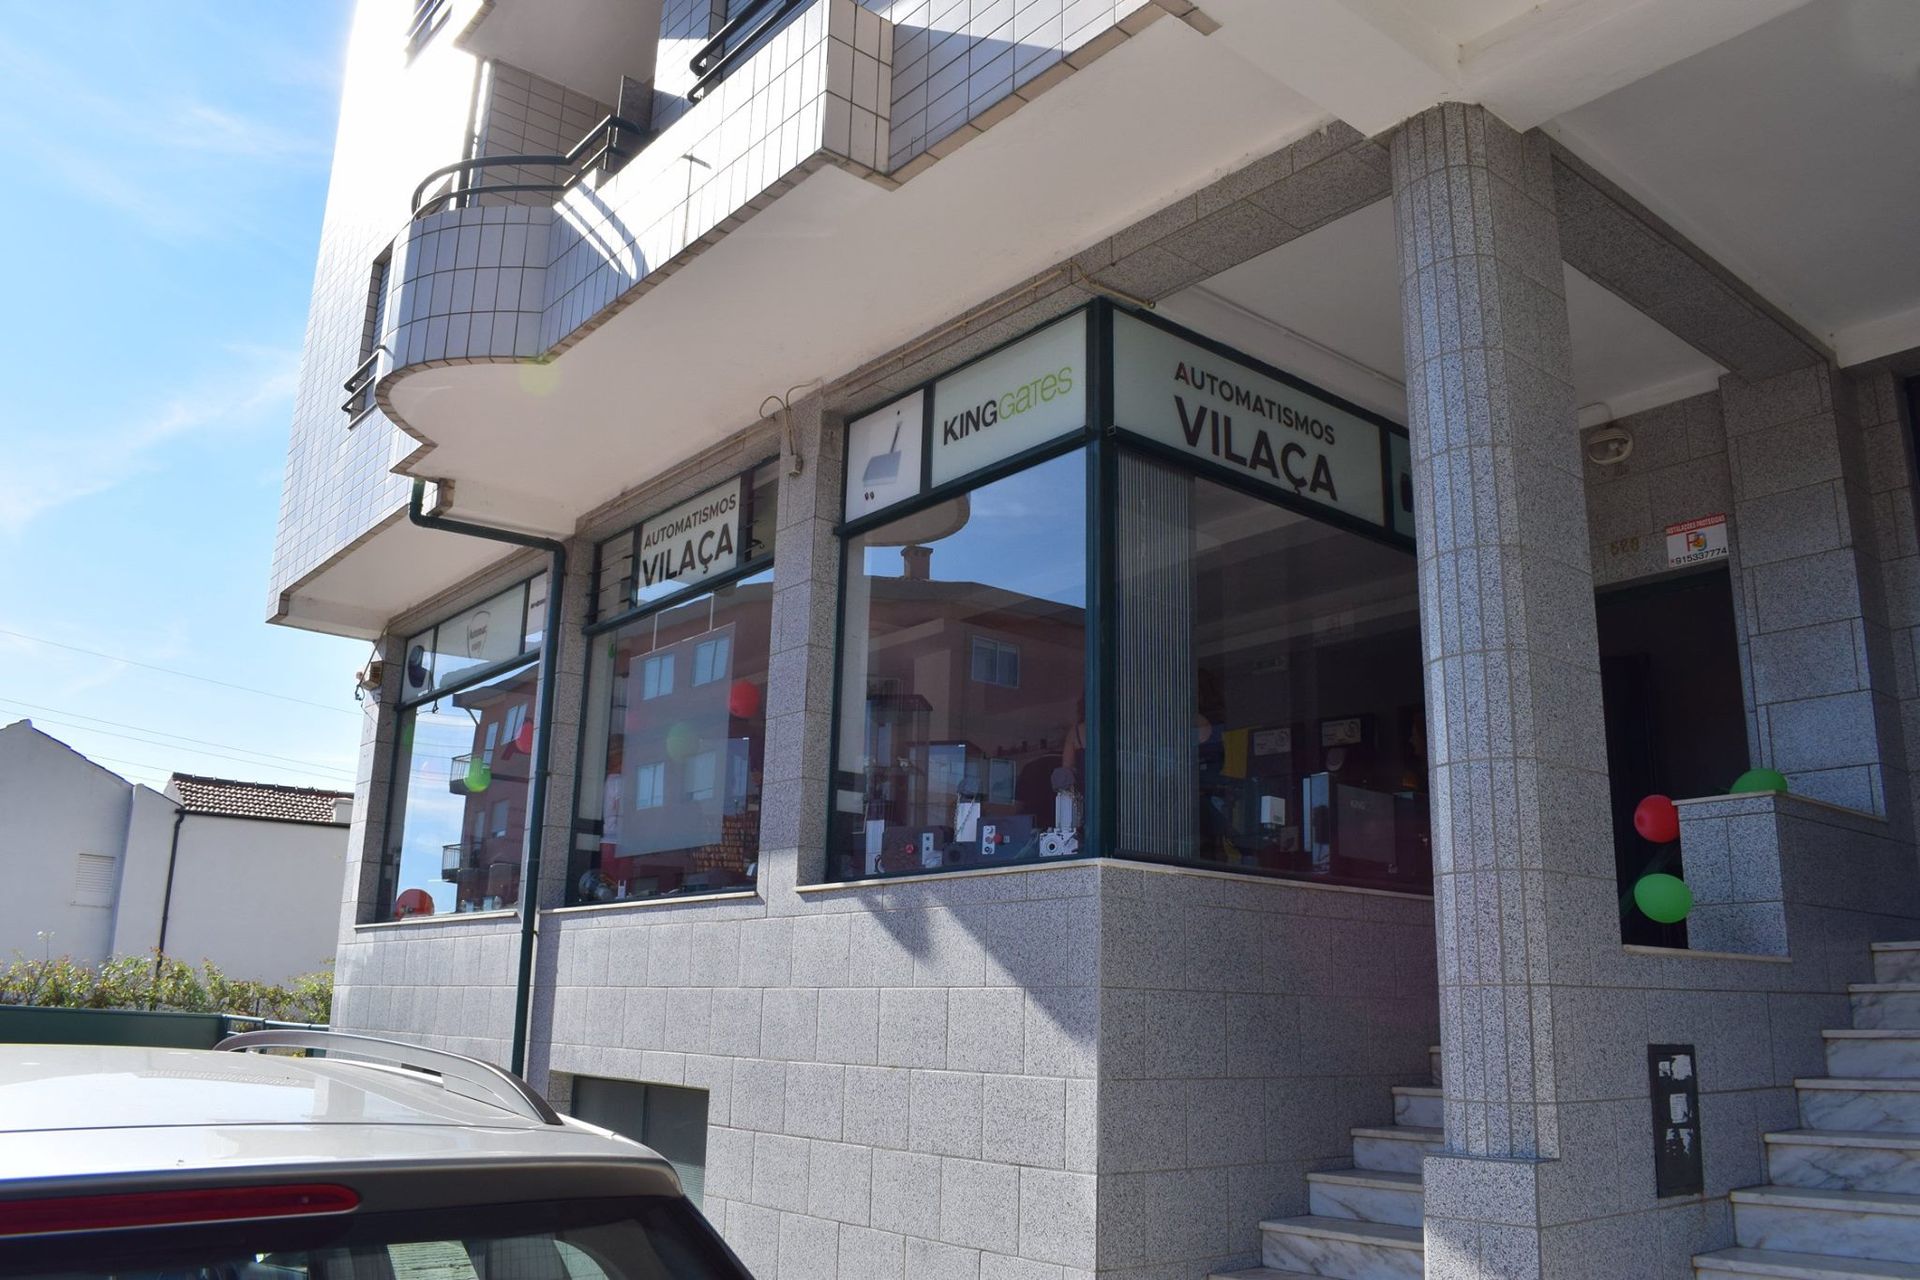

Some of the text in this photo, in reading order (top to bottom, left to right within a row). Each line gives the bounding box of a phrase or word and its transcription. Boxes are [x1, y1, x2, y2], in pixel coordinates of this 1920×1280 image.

[1174, 361, 1335, 446] AUTOMATISMOS
[1174, 395, 1338, 502] VILAÇA
[642, 522, 734, 587] VILAÇA
[643, 493, 737, 551] AUTOMATISMOS
[1675, 547, 1727, 565] 915337774
